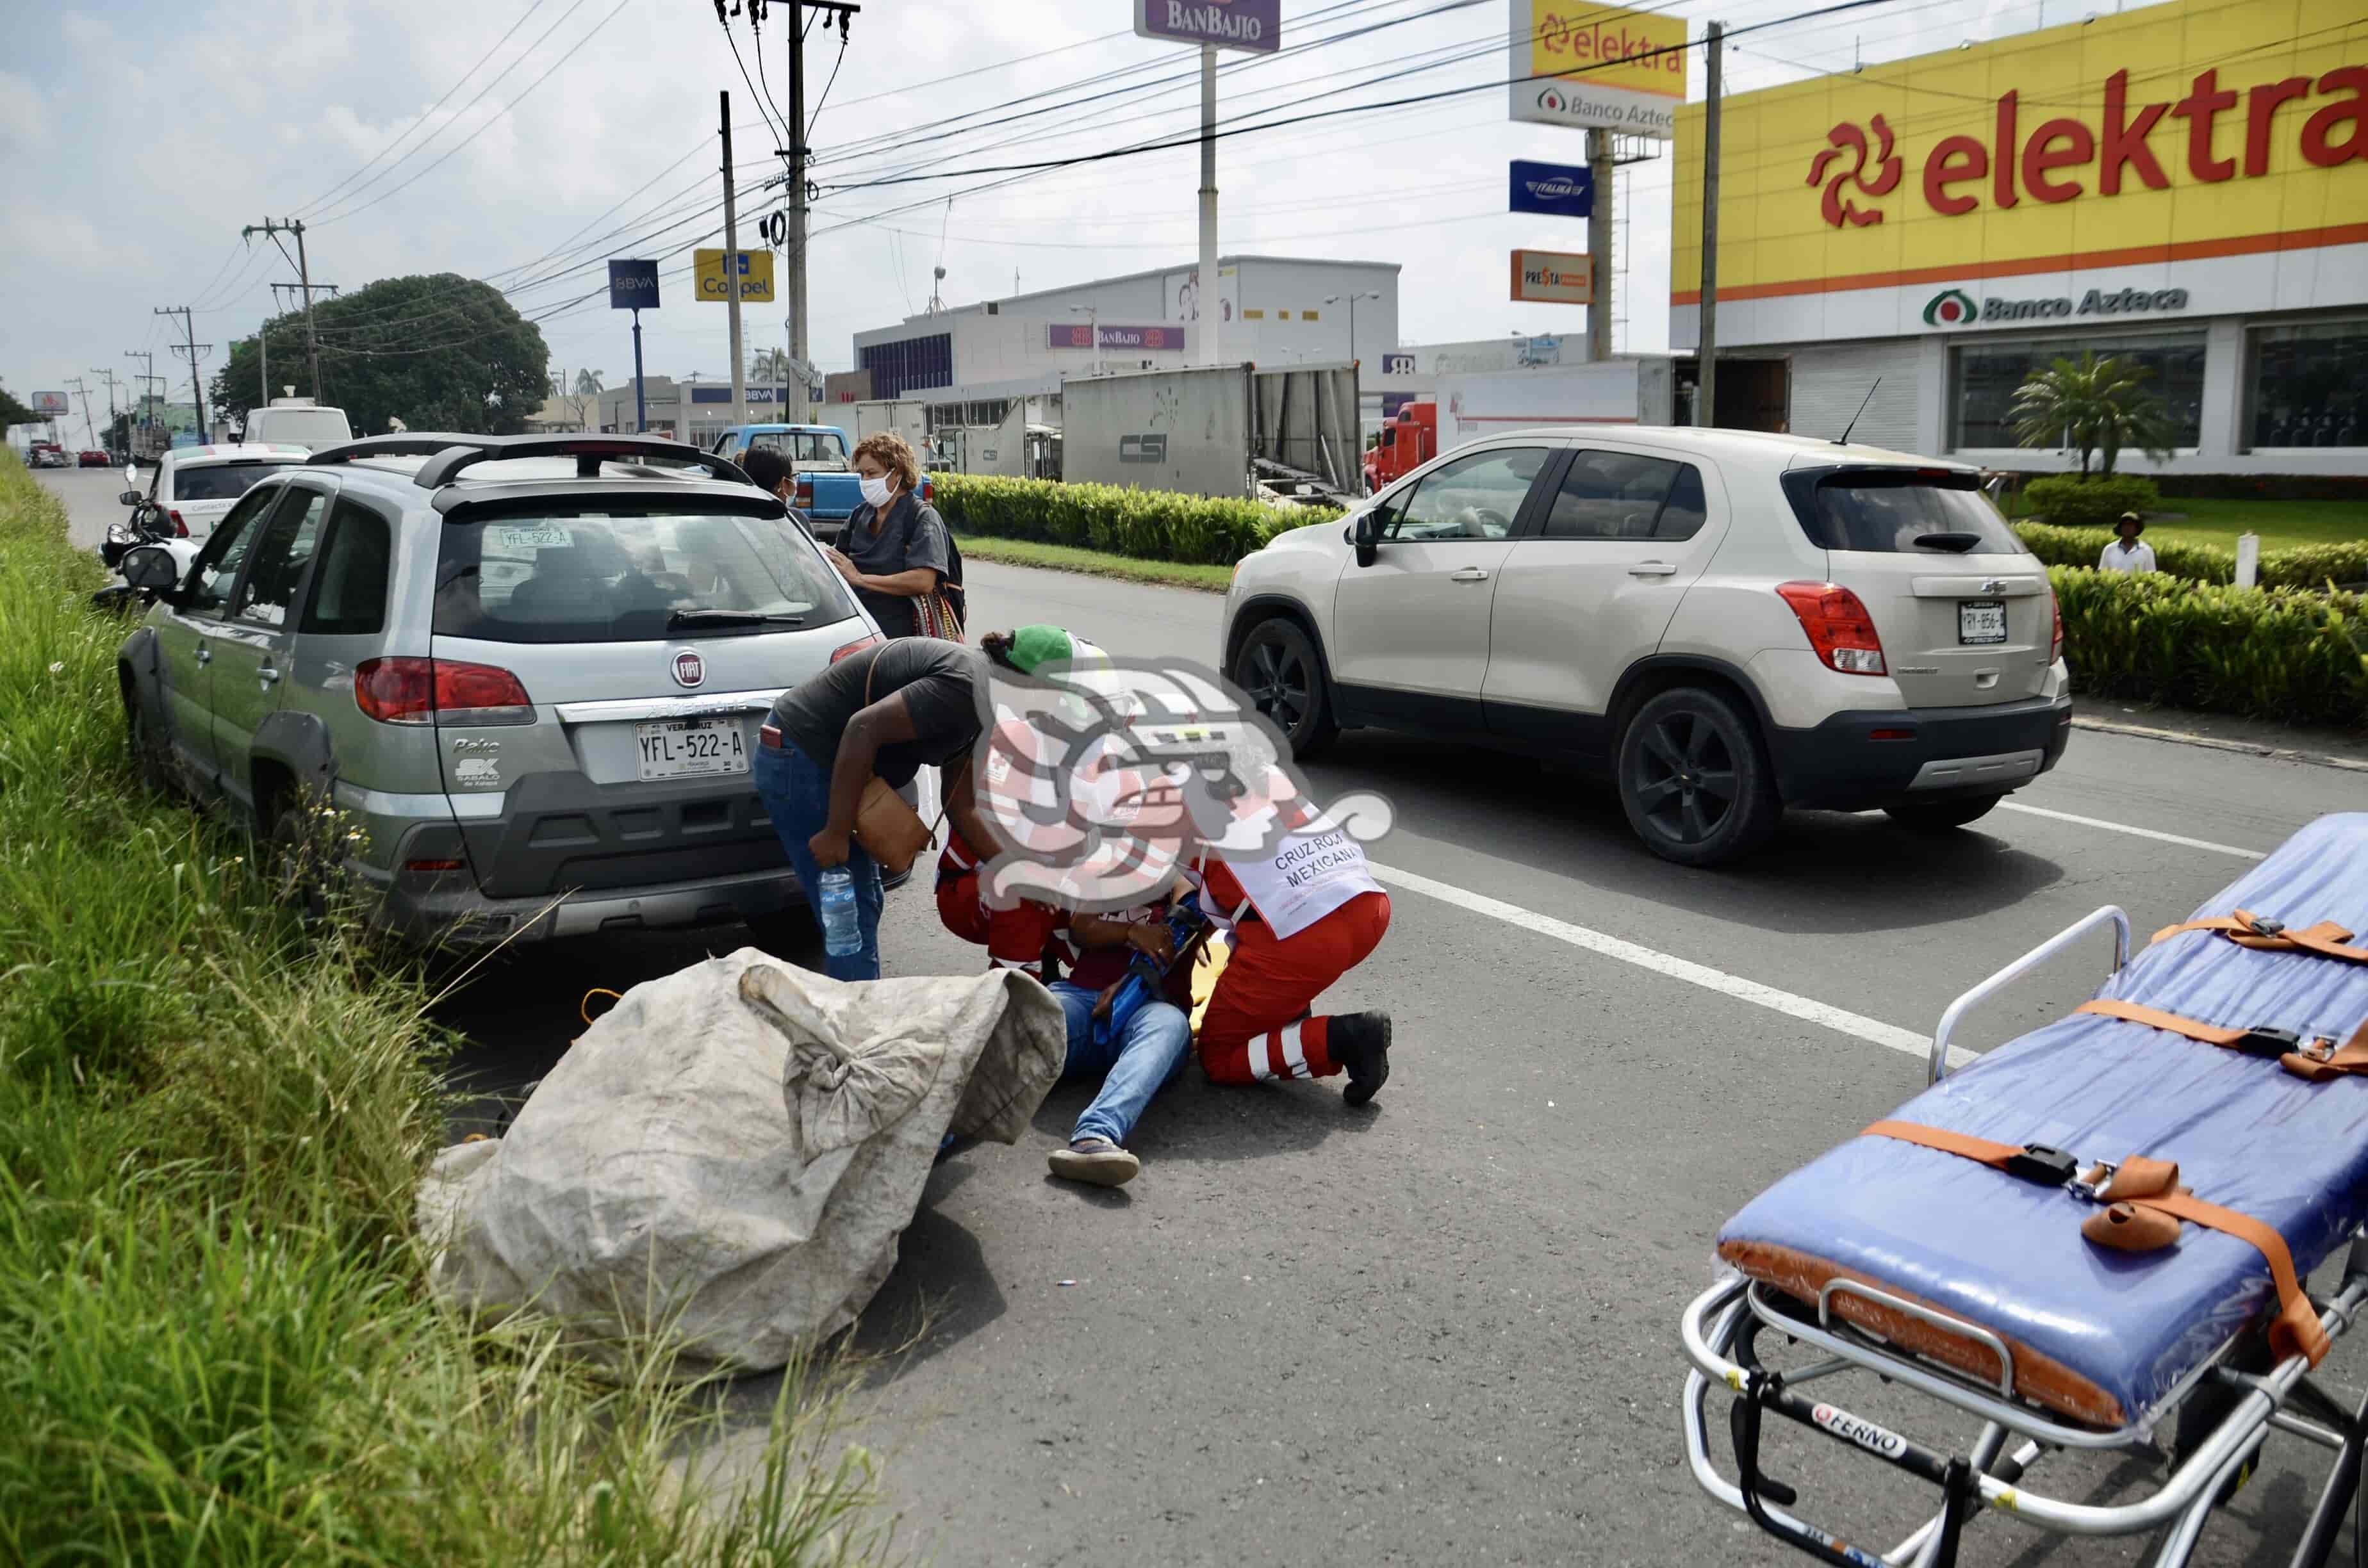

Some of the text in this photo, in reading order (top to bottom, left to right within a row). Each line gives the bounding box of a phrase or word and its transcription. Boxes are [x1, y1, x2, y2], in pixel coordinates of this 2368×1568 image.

[1574, 22, 1682, 74] elektra
[1570, 96, 1673, 127] Banco Aztec
[1923, 67, 2368, 216] elektra
[616, 276, 655, 289] BBVA
[704, 277, 769, 297] Copel
[1980, 288, 2189, 321] Banco Azteca
[745, 389, 773, 400] BBVA
[507, 532, 565, 545] YFL-522-A
[680, 661, 699, 678] FIAT
[640, 731, 742, 761] YFL-522-A
[1275, 843, 1315, 870] CRUZ
[1830, 1414, 1898, 1451] FERNO
